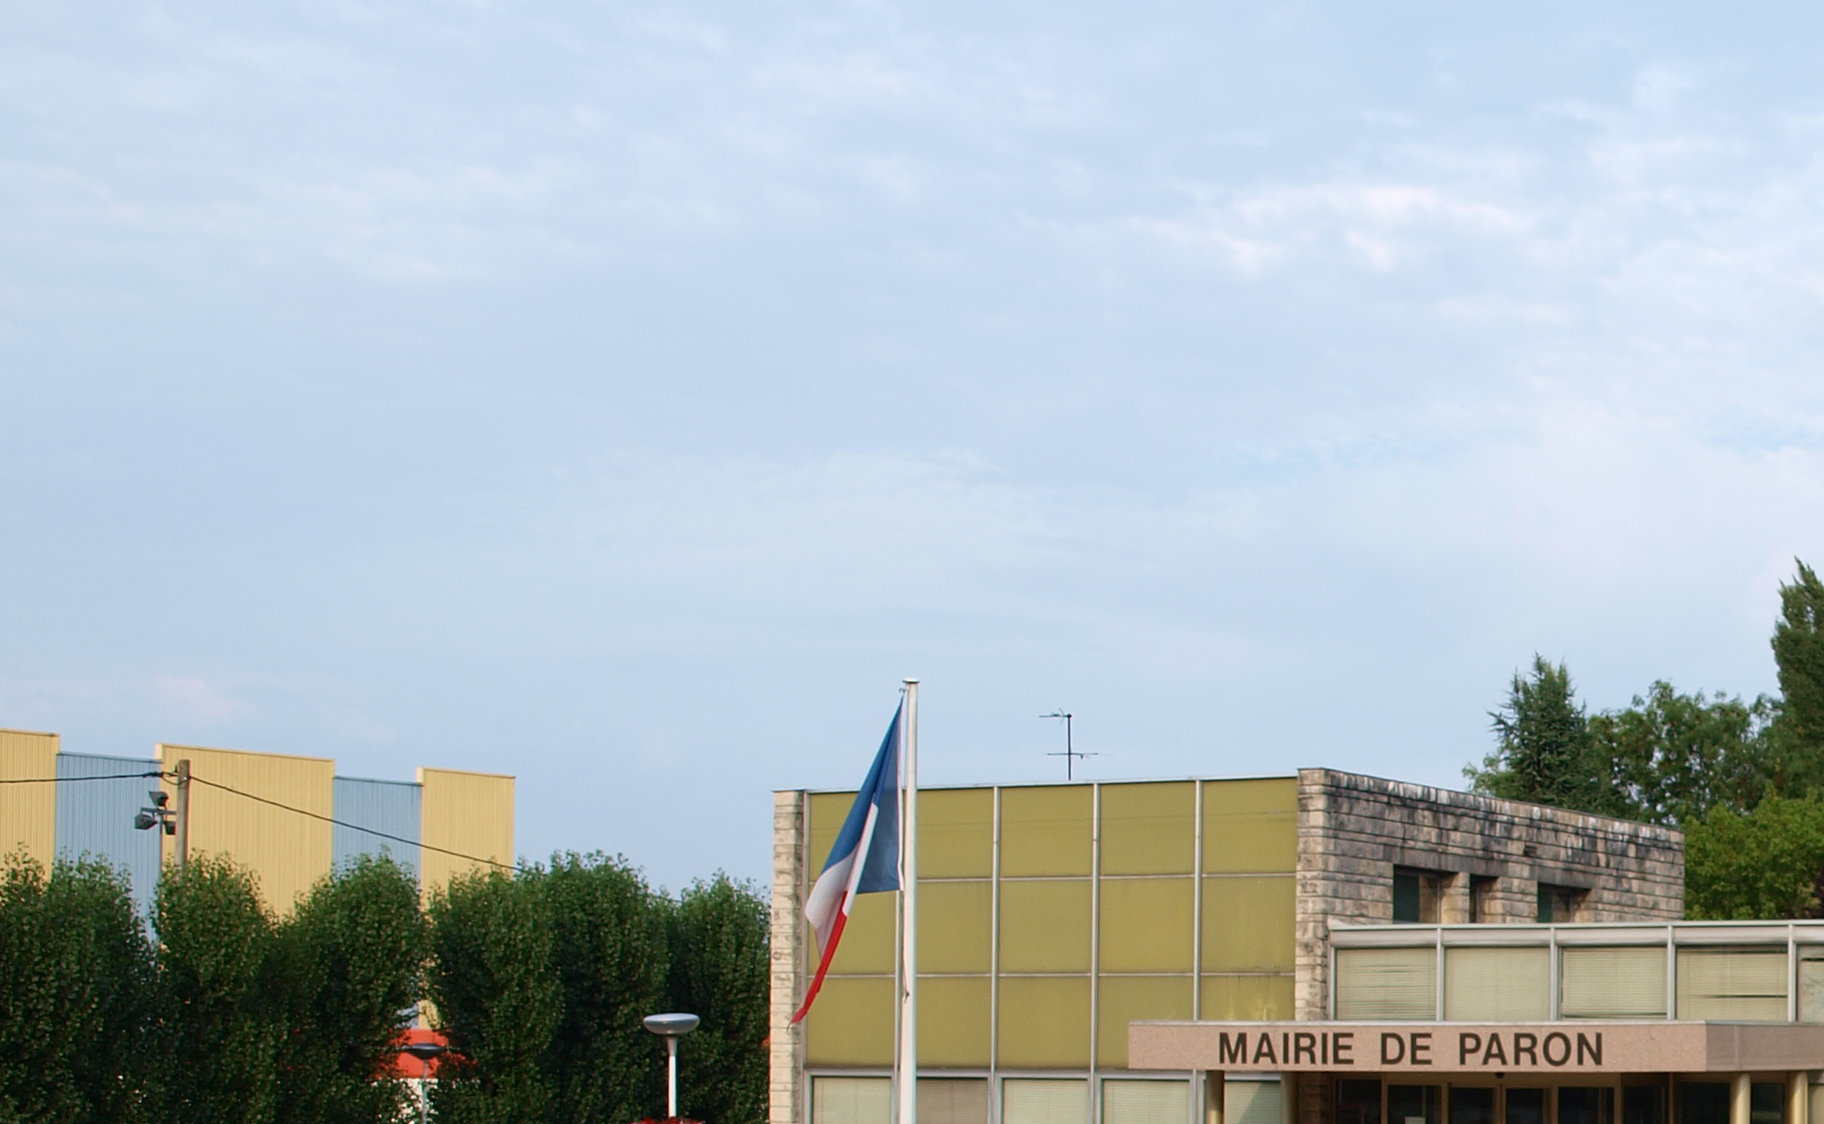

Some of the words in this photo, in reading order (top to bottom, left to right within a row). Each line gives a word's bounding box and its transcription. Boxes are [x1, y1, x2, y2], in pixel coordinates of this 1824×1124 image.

[1219, 1032, 1354, 1065] MAIRIE
[1380, 1032, 1432, 1065] DE
[1459, 1032, 1602, 1066] PARON
